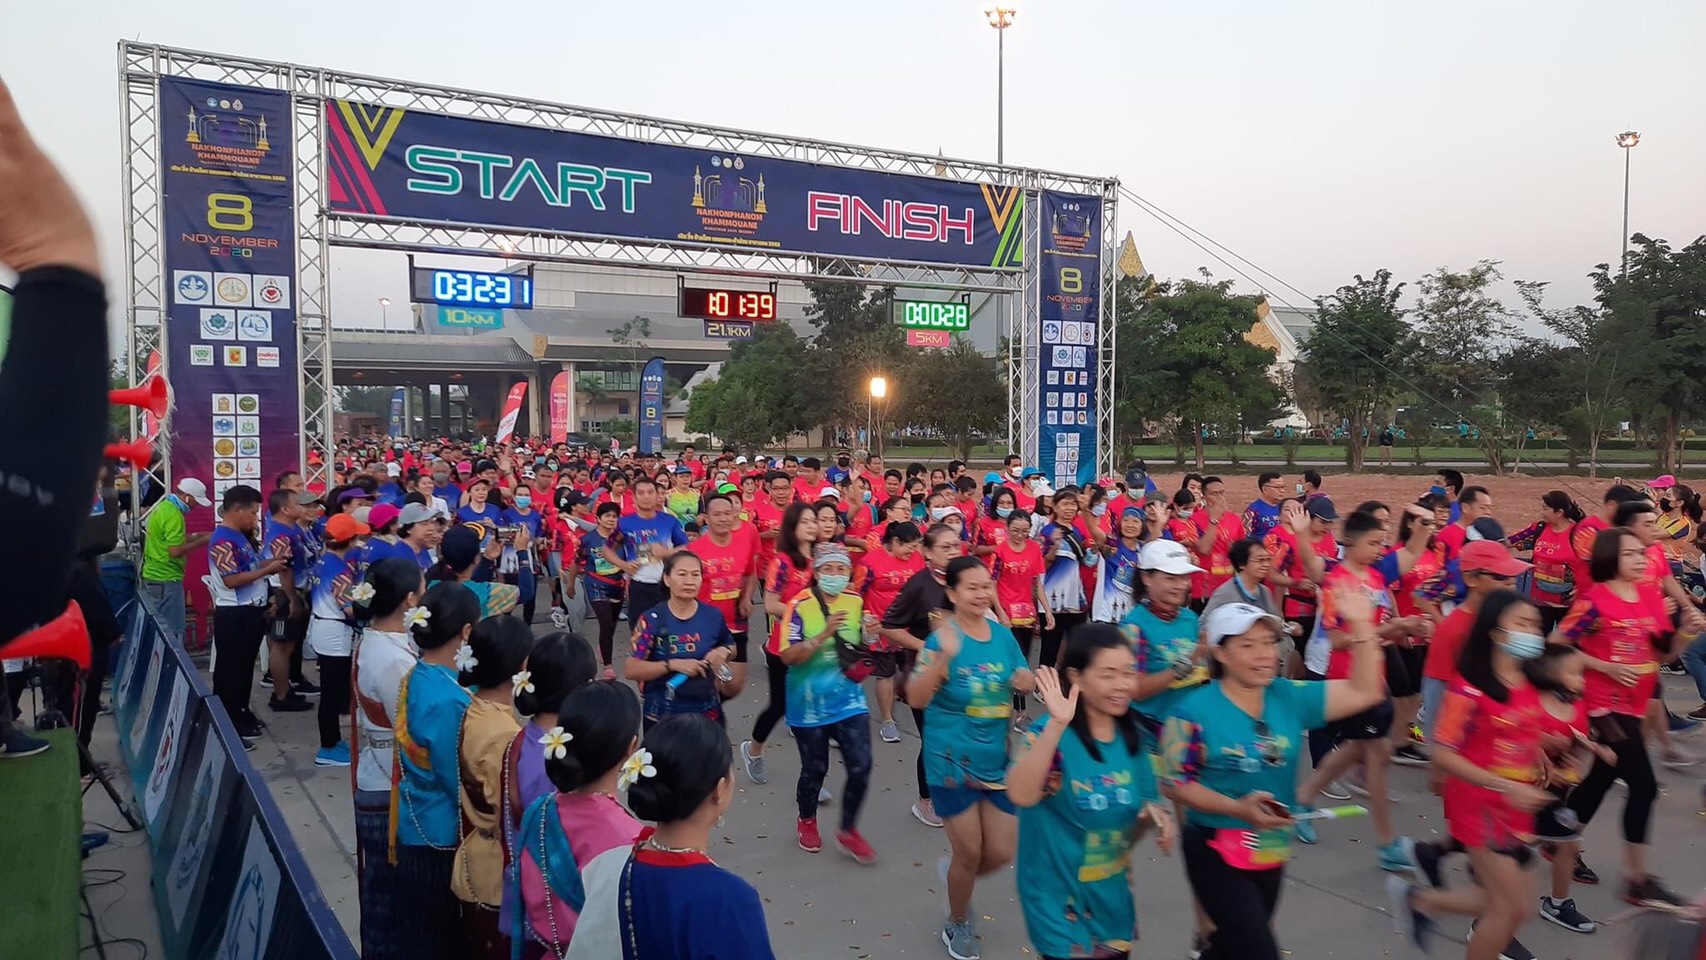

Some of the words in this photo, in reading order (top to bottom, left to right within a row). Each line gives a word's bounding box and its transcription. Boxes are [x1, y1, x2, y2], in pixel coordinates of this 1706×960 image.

[405, 144, 652, 213] START
[207, 193, 254, 231] 8
[696, 207, 763, 221] NAKHONPHANOM
[807, 191, 974, 245] FINISH
[702, 217, 758, 230] KHAMMOUANE
[182, 232, 279, 249] NOVEMBER
[210, 246, 253, 258] 2020
[436, 271, 529, 304] 0:32:31
[1060, 267, 1082, 293] 8
[905, 302, 967, 327] 0:00:28
[707, 322, 751, 337] 21.1KM
[915, 331, 943, 344] 5KM
[646, 407, 656, 418] 8
